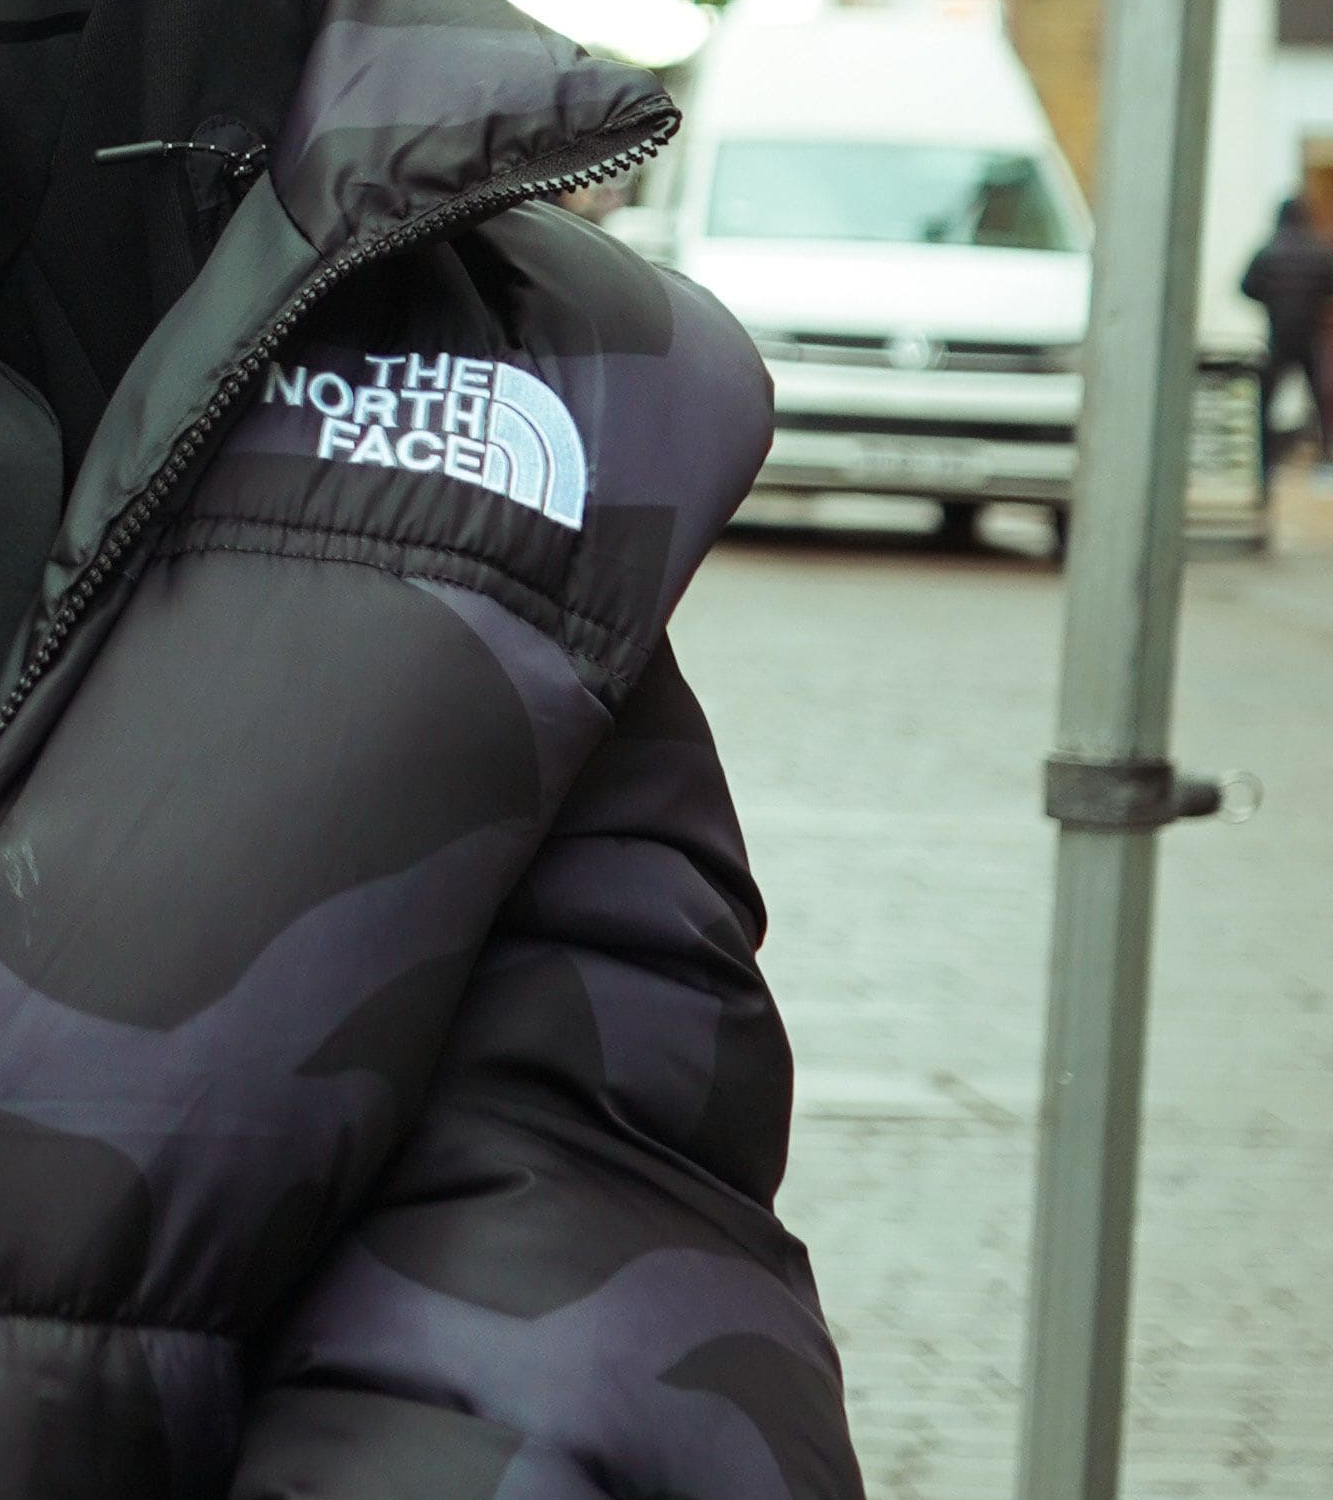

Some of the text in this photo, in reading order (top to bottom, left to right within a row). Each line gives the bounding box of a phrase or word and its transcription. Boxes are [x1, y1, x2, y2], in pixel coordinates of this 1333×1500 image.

[264, 361, 487, 441] NORTH
[365, 352, 495, 398] THE
[318, 417, 484, 486] FACE
